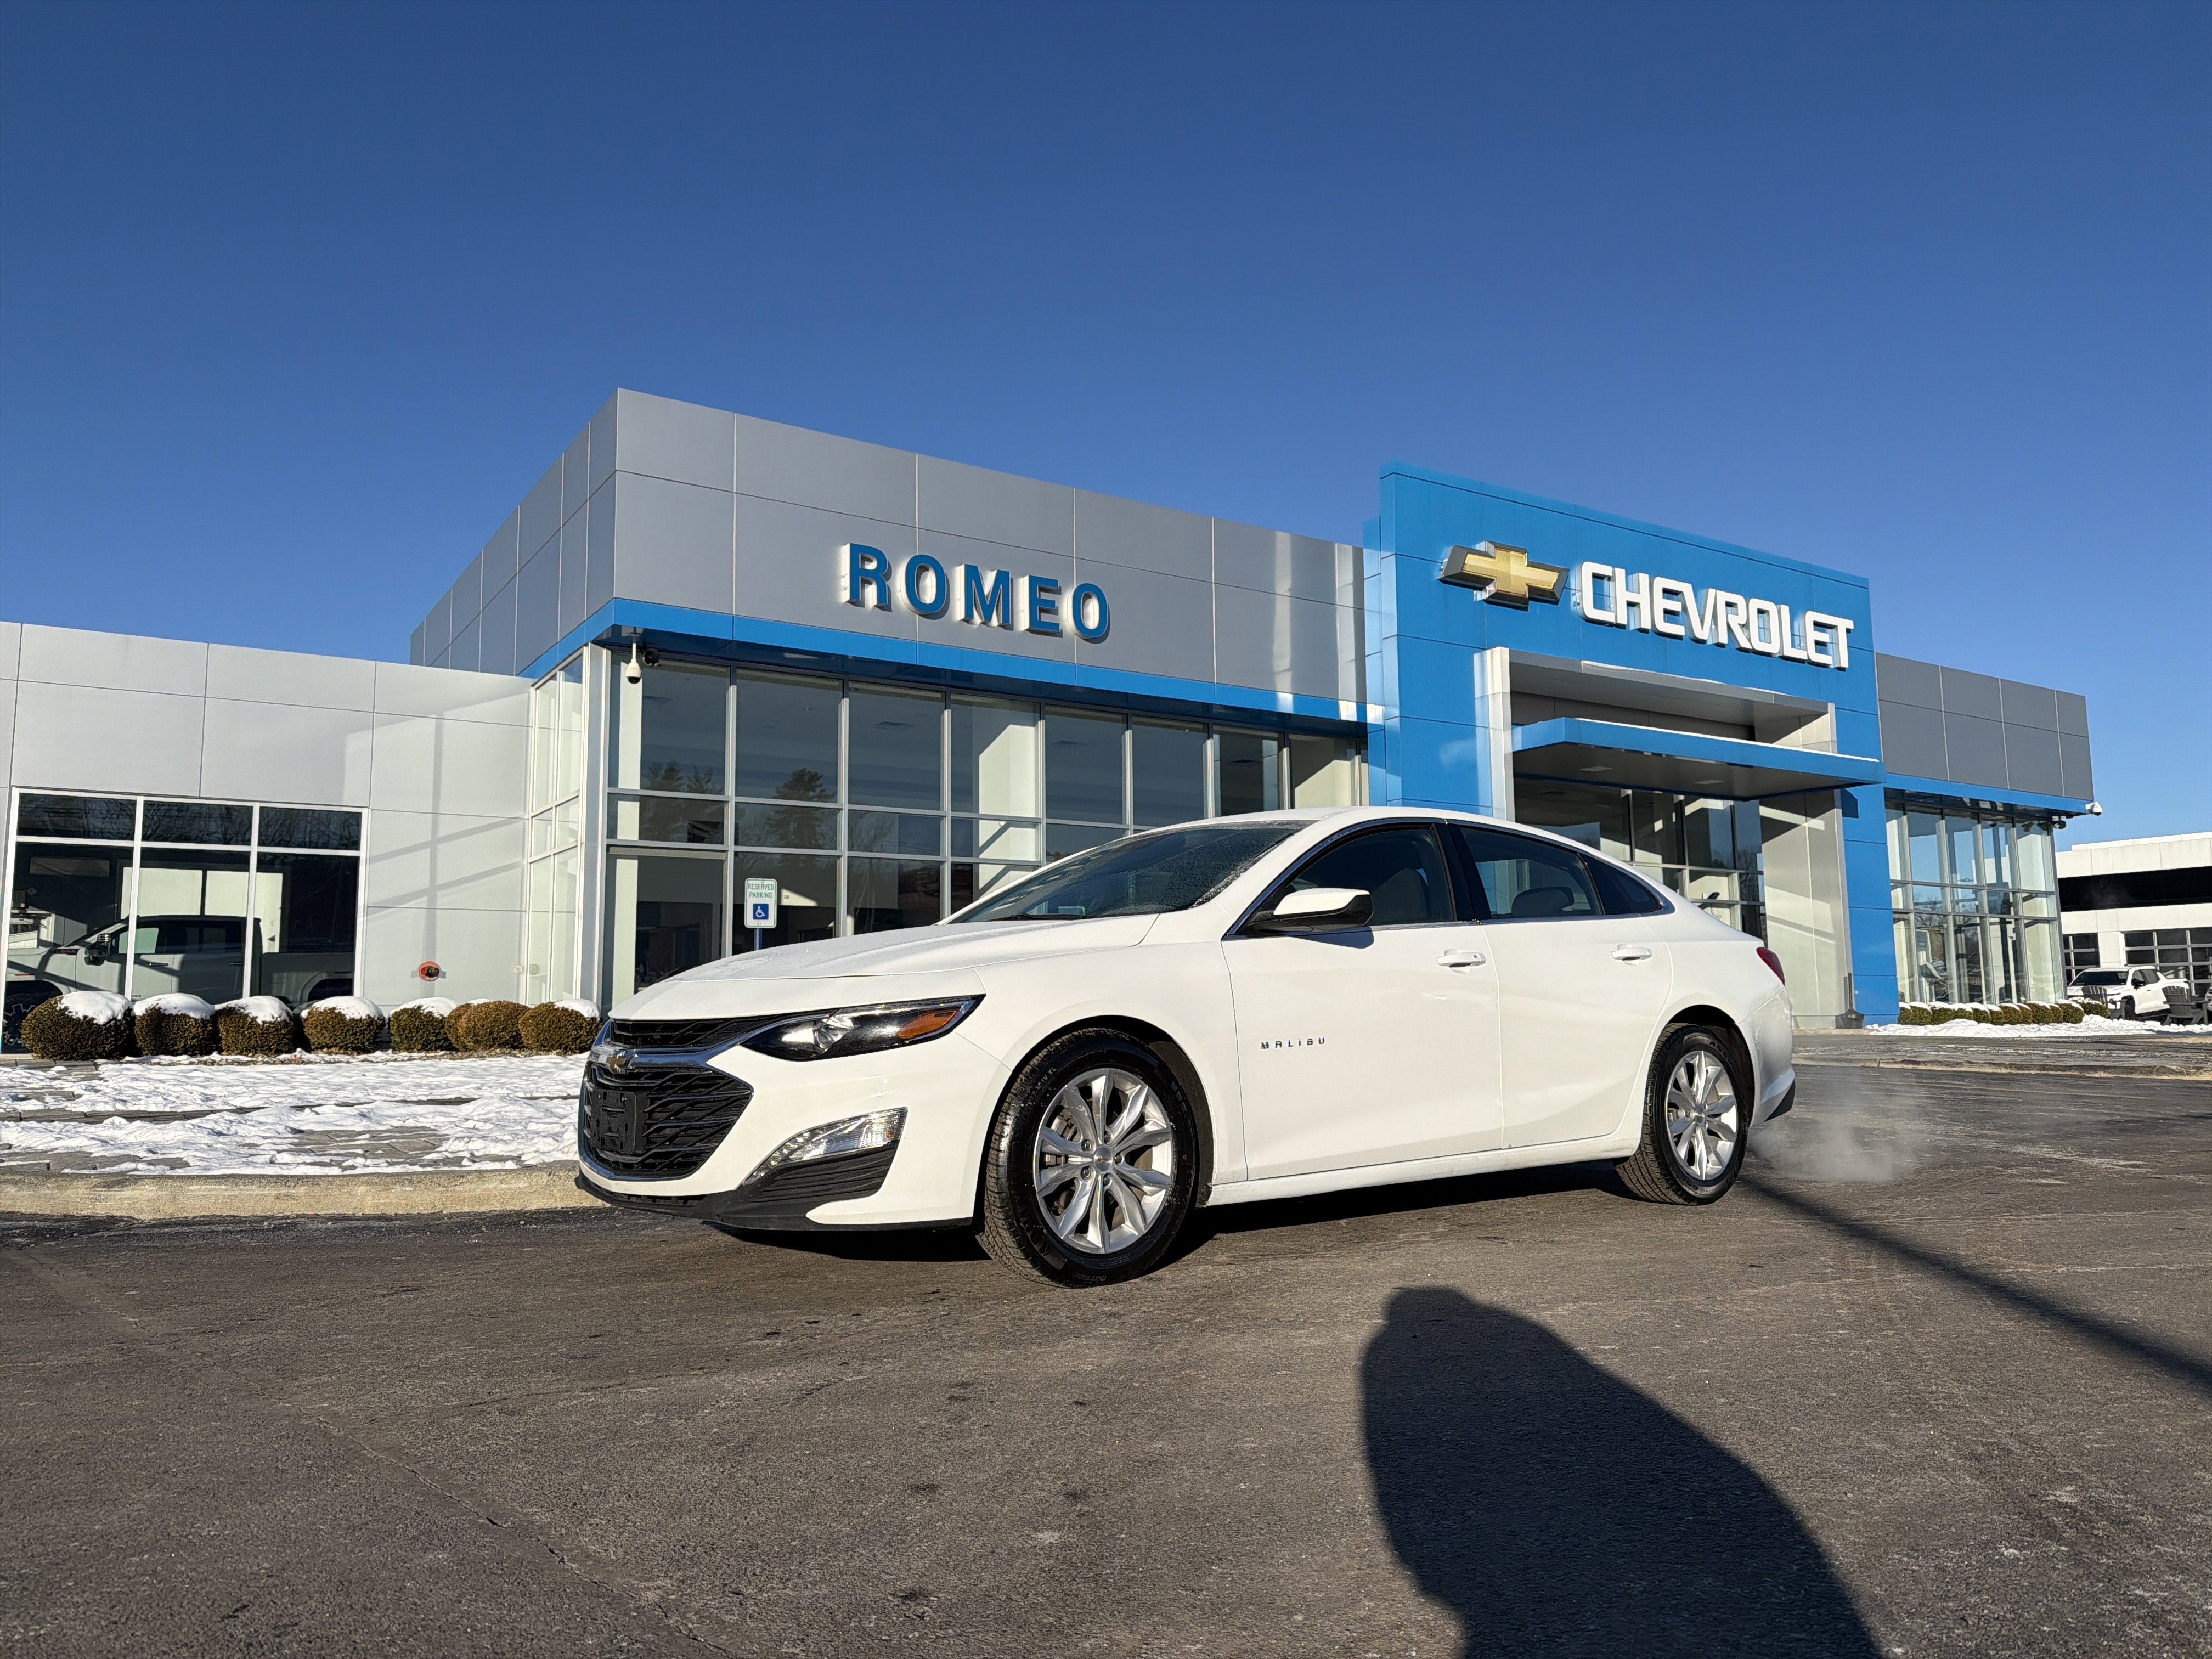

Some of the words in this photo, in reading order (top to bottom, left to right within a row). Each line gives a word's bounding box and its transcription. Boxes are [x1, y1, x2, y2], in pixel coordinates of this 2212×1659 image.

[845, 542, 1110, 639] ROMEO
[1578, 561, 1854, 670] CHEVROLET
[1260, 1036, 1325, 1049] MALIBU
